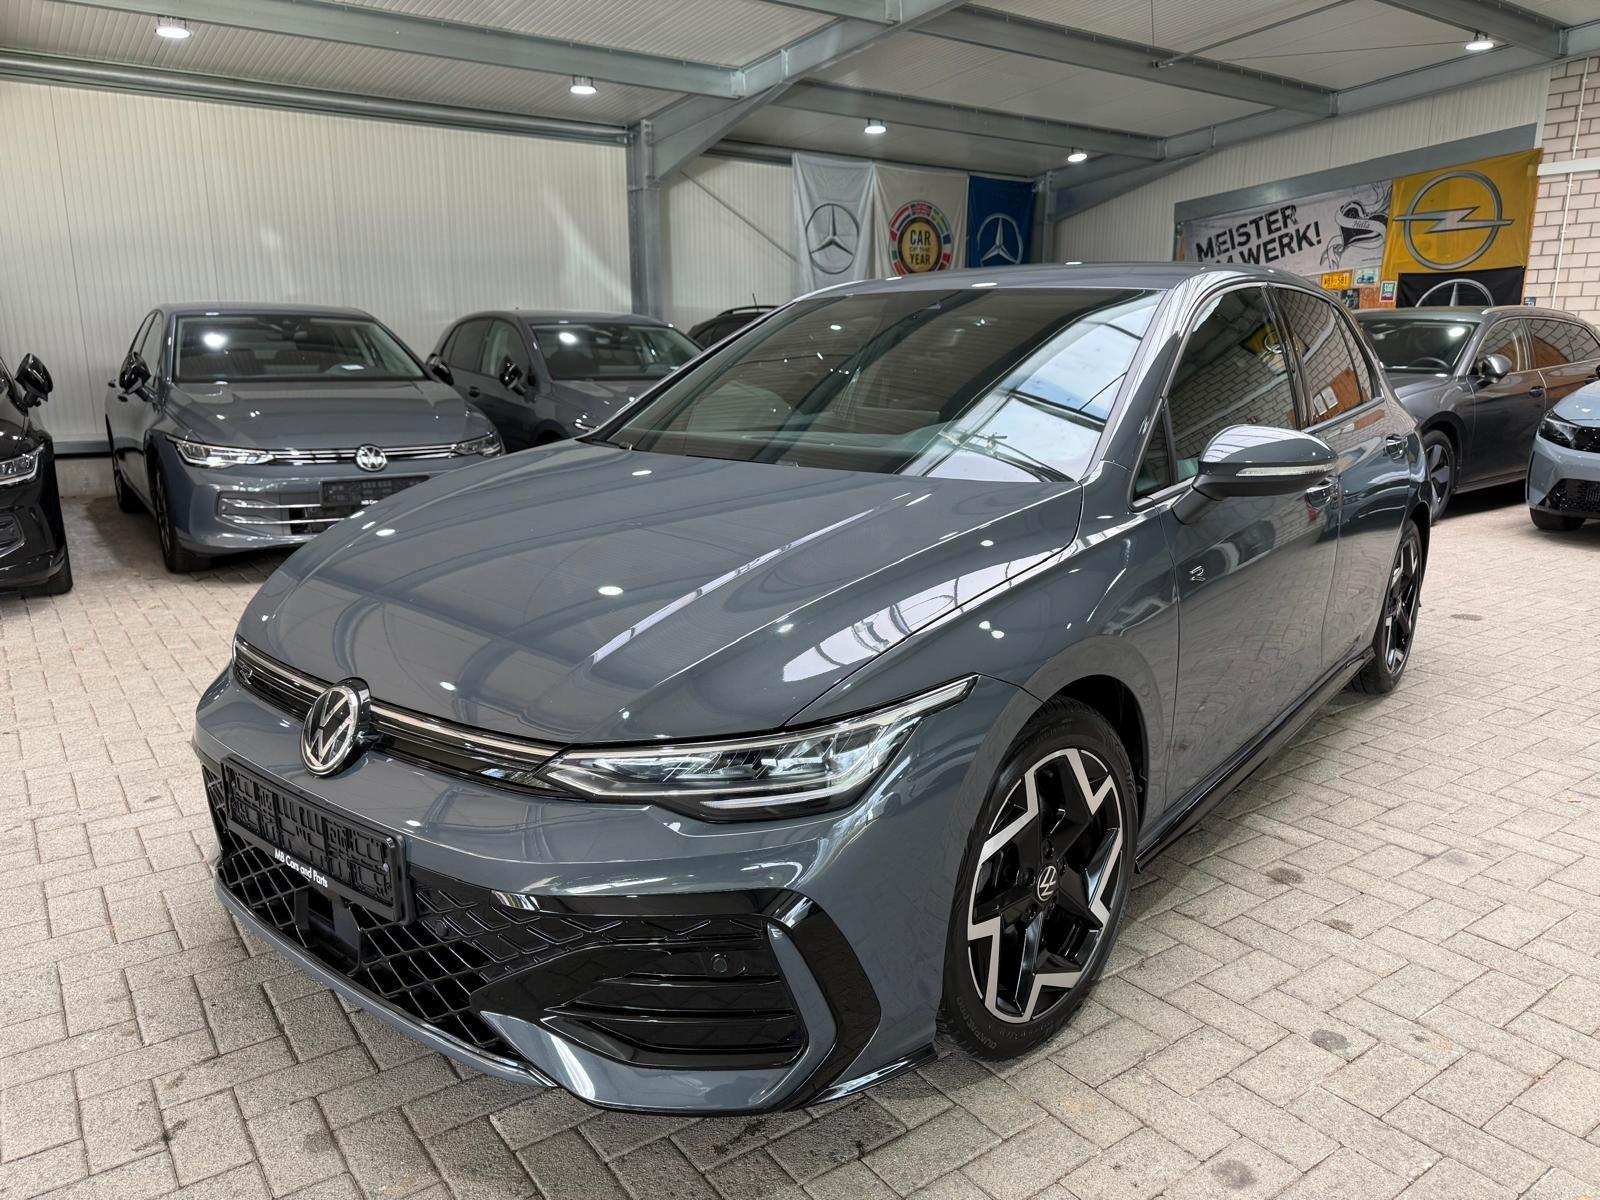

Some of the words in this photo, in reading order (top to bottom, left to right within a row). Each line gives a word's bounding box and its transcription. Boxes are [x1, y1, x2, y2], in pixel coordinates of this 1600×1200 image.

[910, 230, 931, 246] CAR
[1195, 204, 1299, 262] MEISTER
[1239, 221, 1322, 265] WERK!
[910, 253, 931, 265] YEAR
[274, 848, 285, 863] MB
[285, 855, 299, 871] Cars
[300, 866, 312, 879] and
[313, 869, 328, 888] Parts
